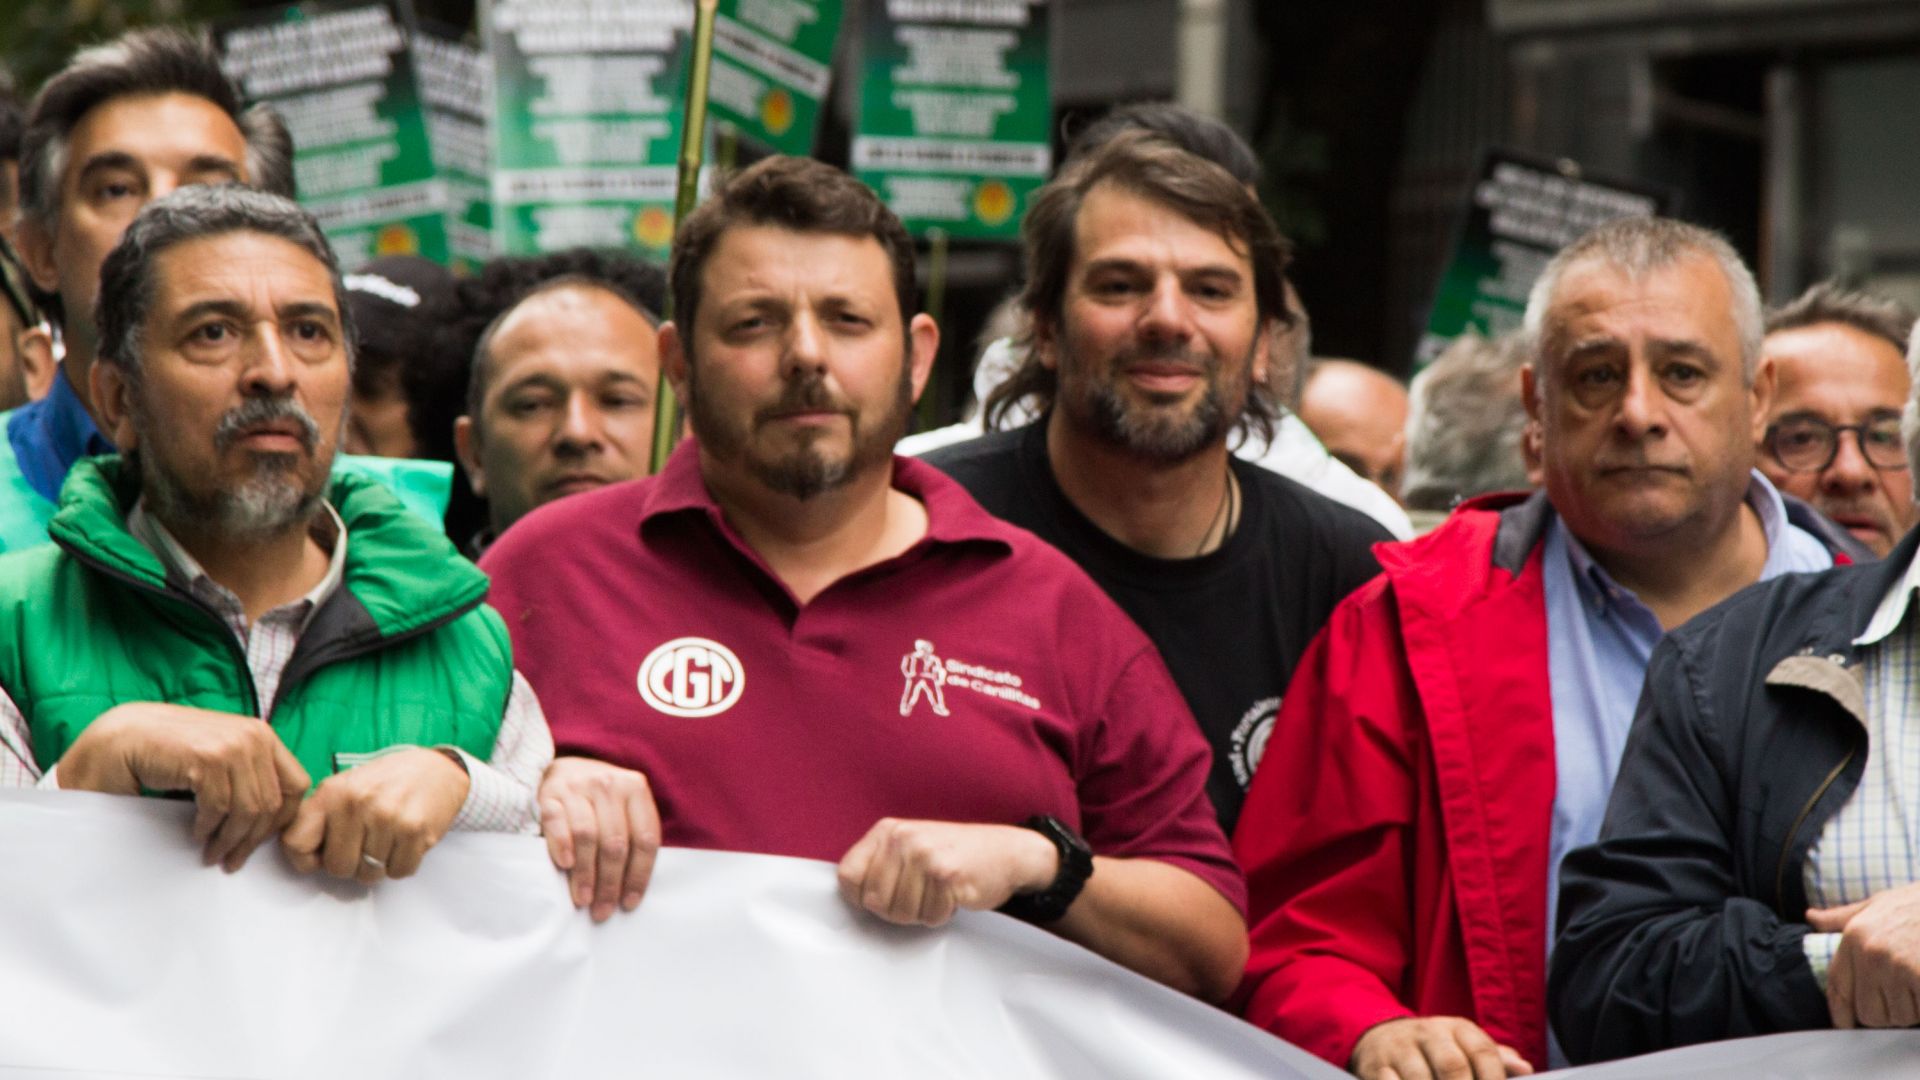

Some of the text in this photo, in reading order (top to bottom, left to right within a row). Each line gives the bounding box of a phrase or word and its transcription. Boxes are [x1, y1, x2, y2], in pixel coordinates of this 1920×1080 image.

[648, 645, 734, 708] CGT
[945, 658, 1022, 687] Sindicato
[946, 675, 970, 688] de
